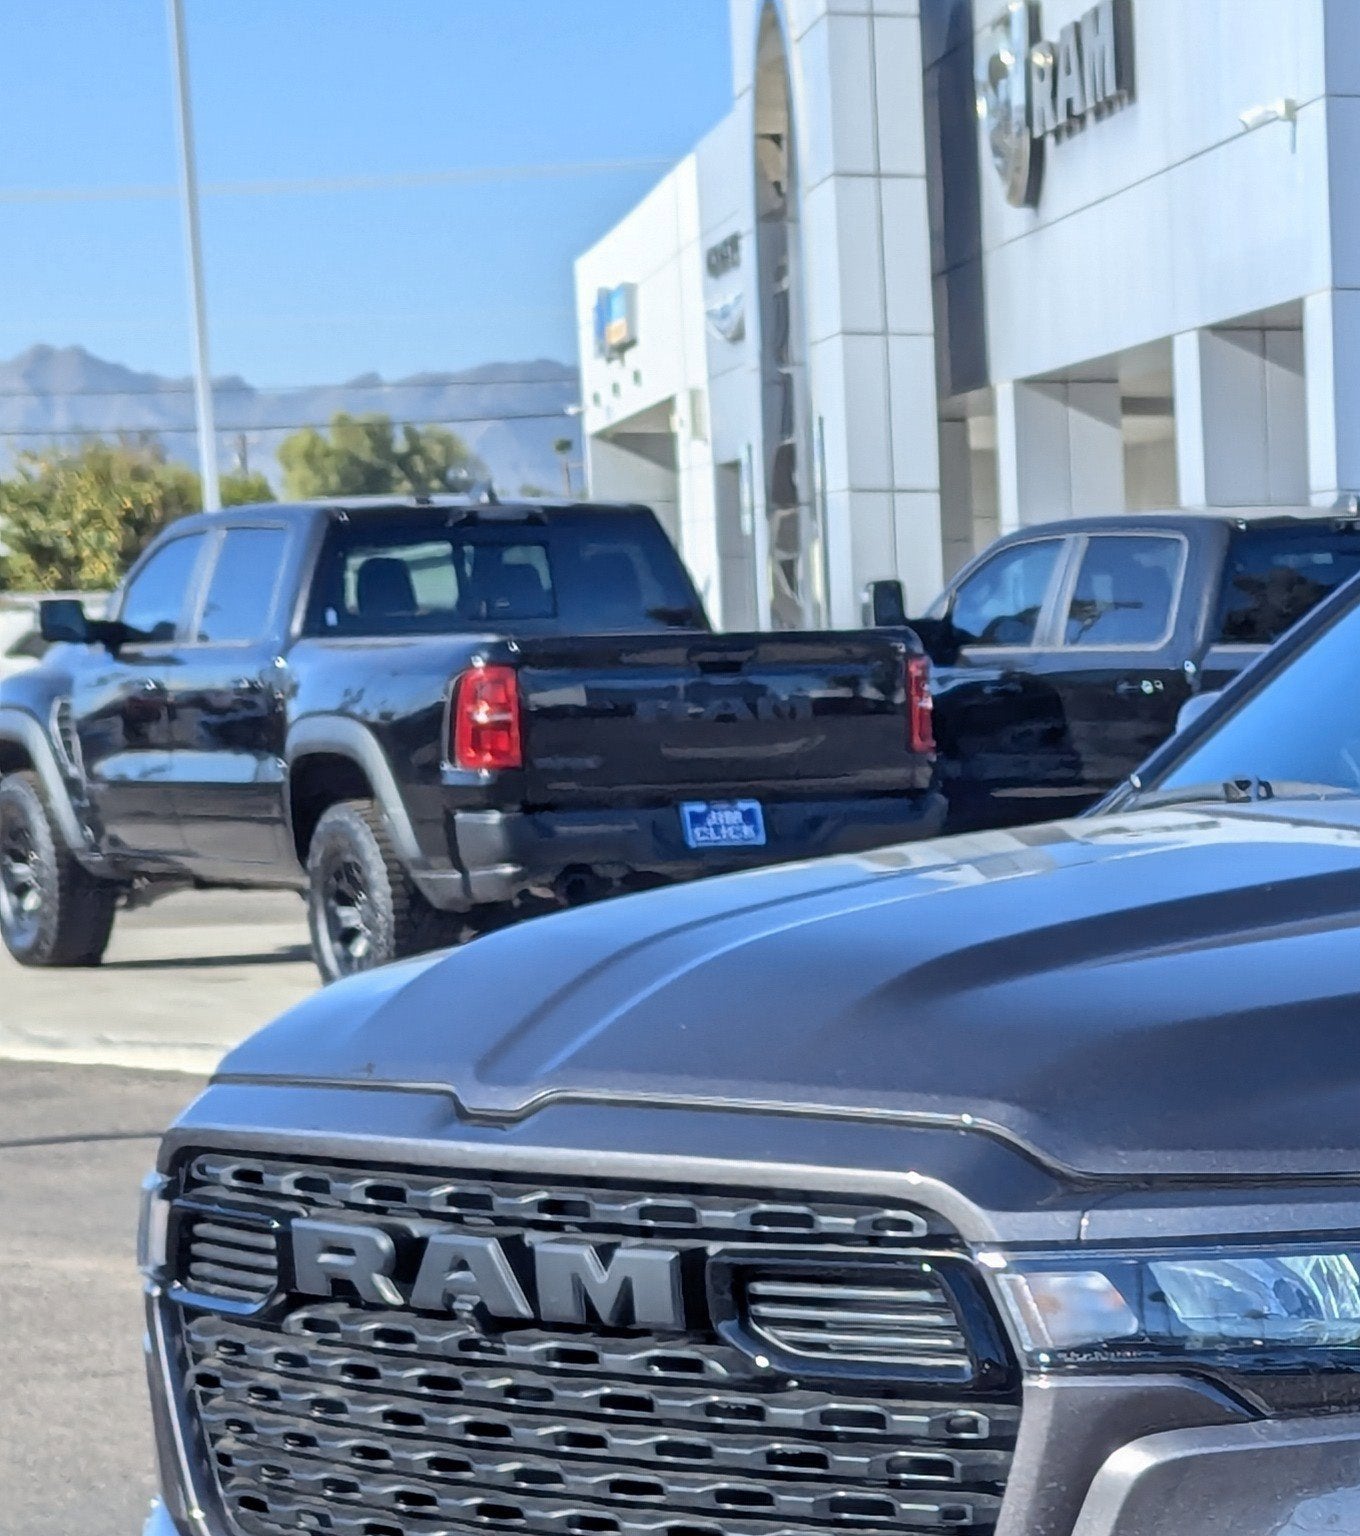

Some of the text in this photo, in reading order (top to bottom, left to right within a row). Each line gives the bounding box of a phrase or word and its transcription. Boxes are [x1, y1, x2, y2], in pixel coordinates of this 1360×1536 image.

[1031, 0, 1118, 139] RAM
[694, 824, 756, 841] CLICK
[706, 810, 743, 826] JIM
[292, 1217, 688, 1334] RAM
